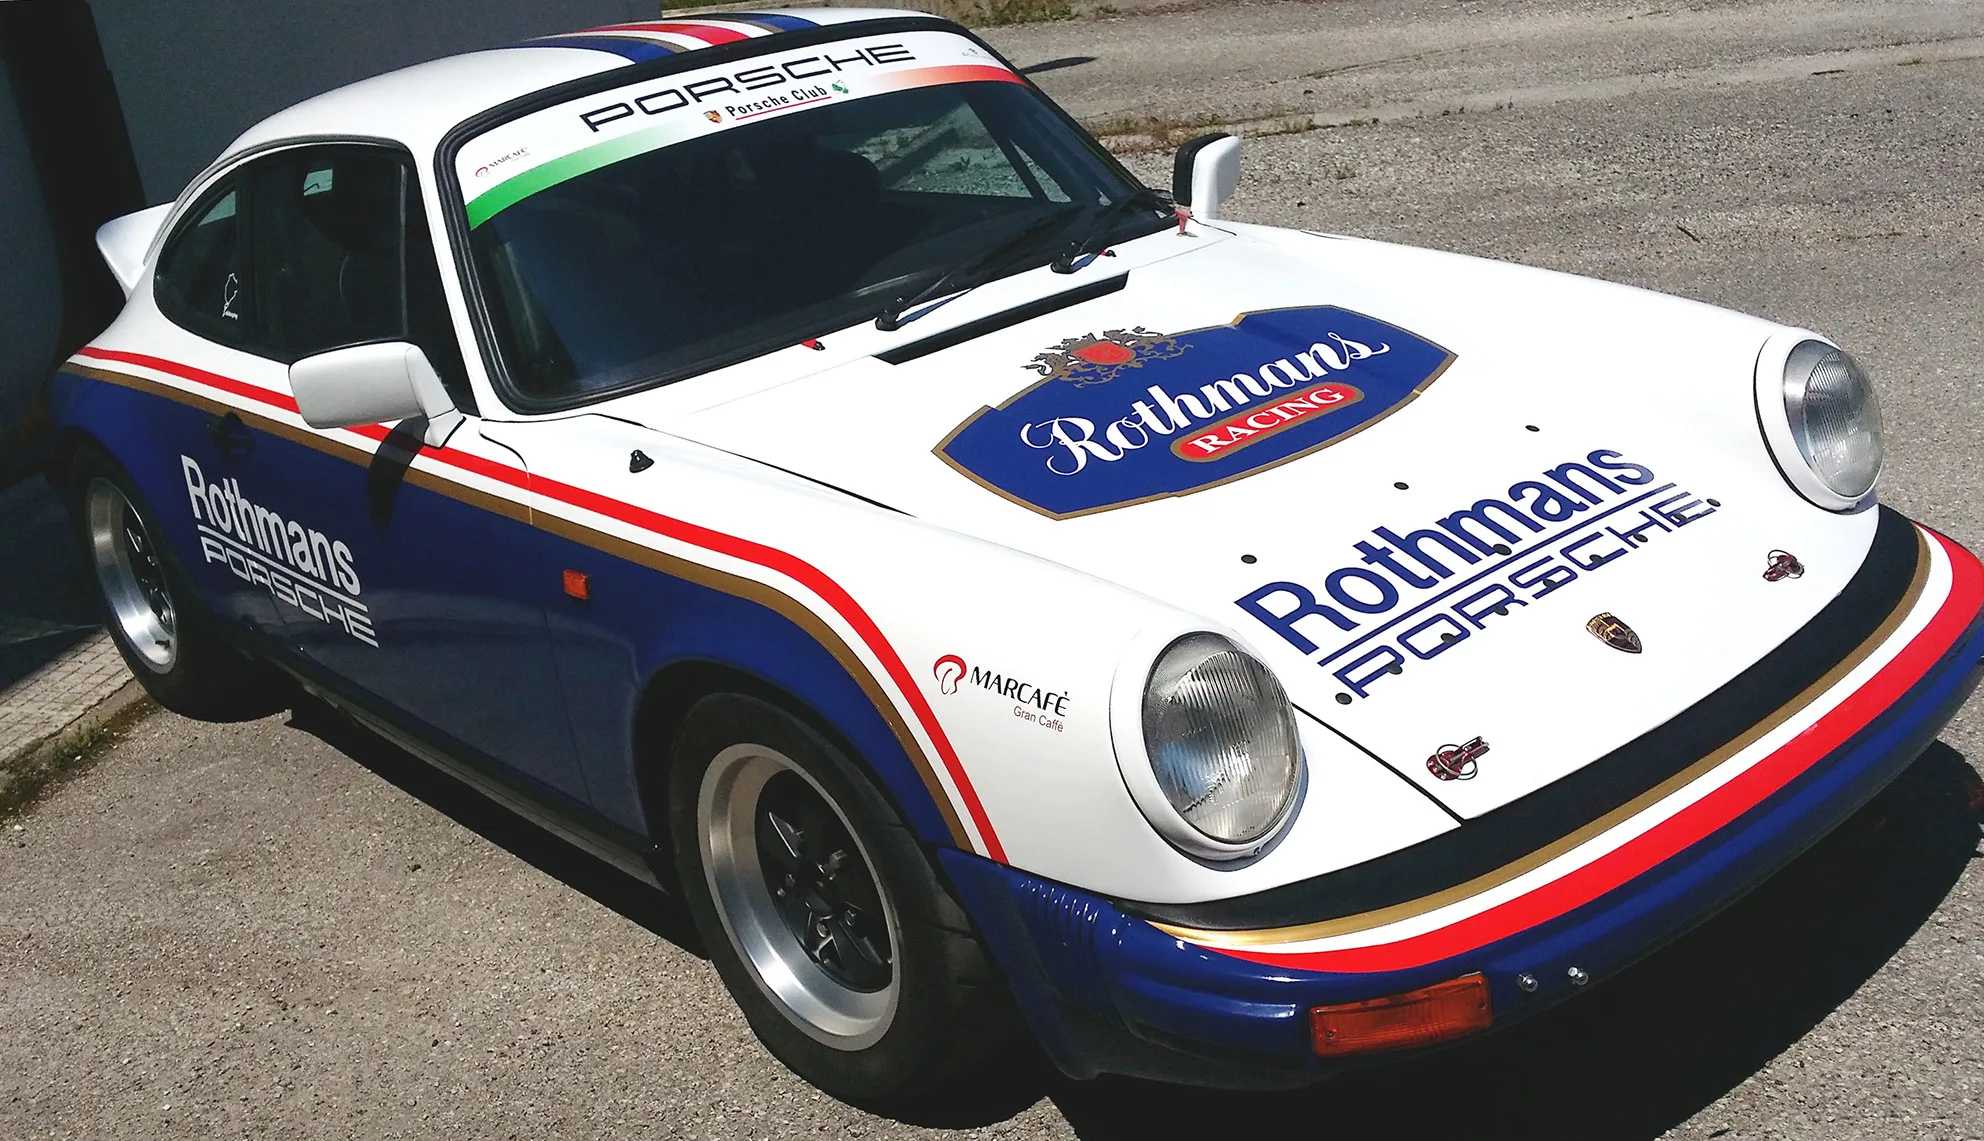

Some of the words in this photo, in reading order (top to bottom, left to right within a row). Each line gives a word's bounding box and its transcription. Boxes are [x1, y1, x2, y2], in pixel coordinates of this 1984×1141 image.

[579, 44, 916, 133] PORSCHE
[725, 95, 789, 117] Porsche
[791, 85, 828, 100] Club
[1020, 331, 1390, 476] Rothmans
[1188, 387, 1344, 454] RACING
[181, 454, 361, 595] Rothmans
[1235, 449, 1655, 655] Rothmans
[201, 536, 380, 648] PORSCHE
[1332, 491, 1717, 699] PORSCHE
[970, 666, 1070, 717] MARCAFÈ
[1013, 706, 1037, 723] Gran
[1038, 714, 1064, 732] Caffè
